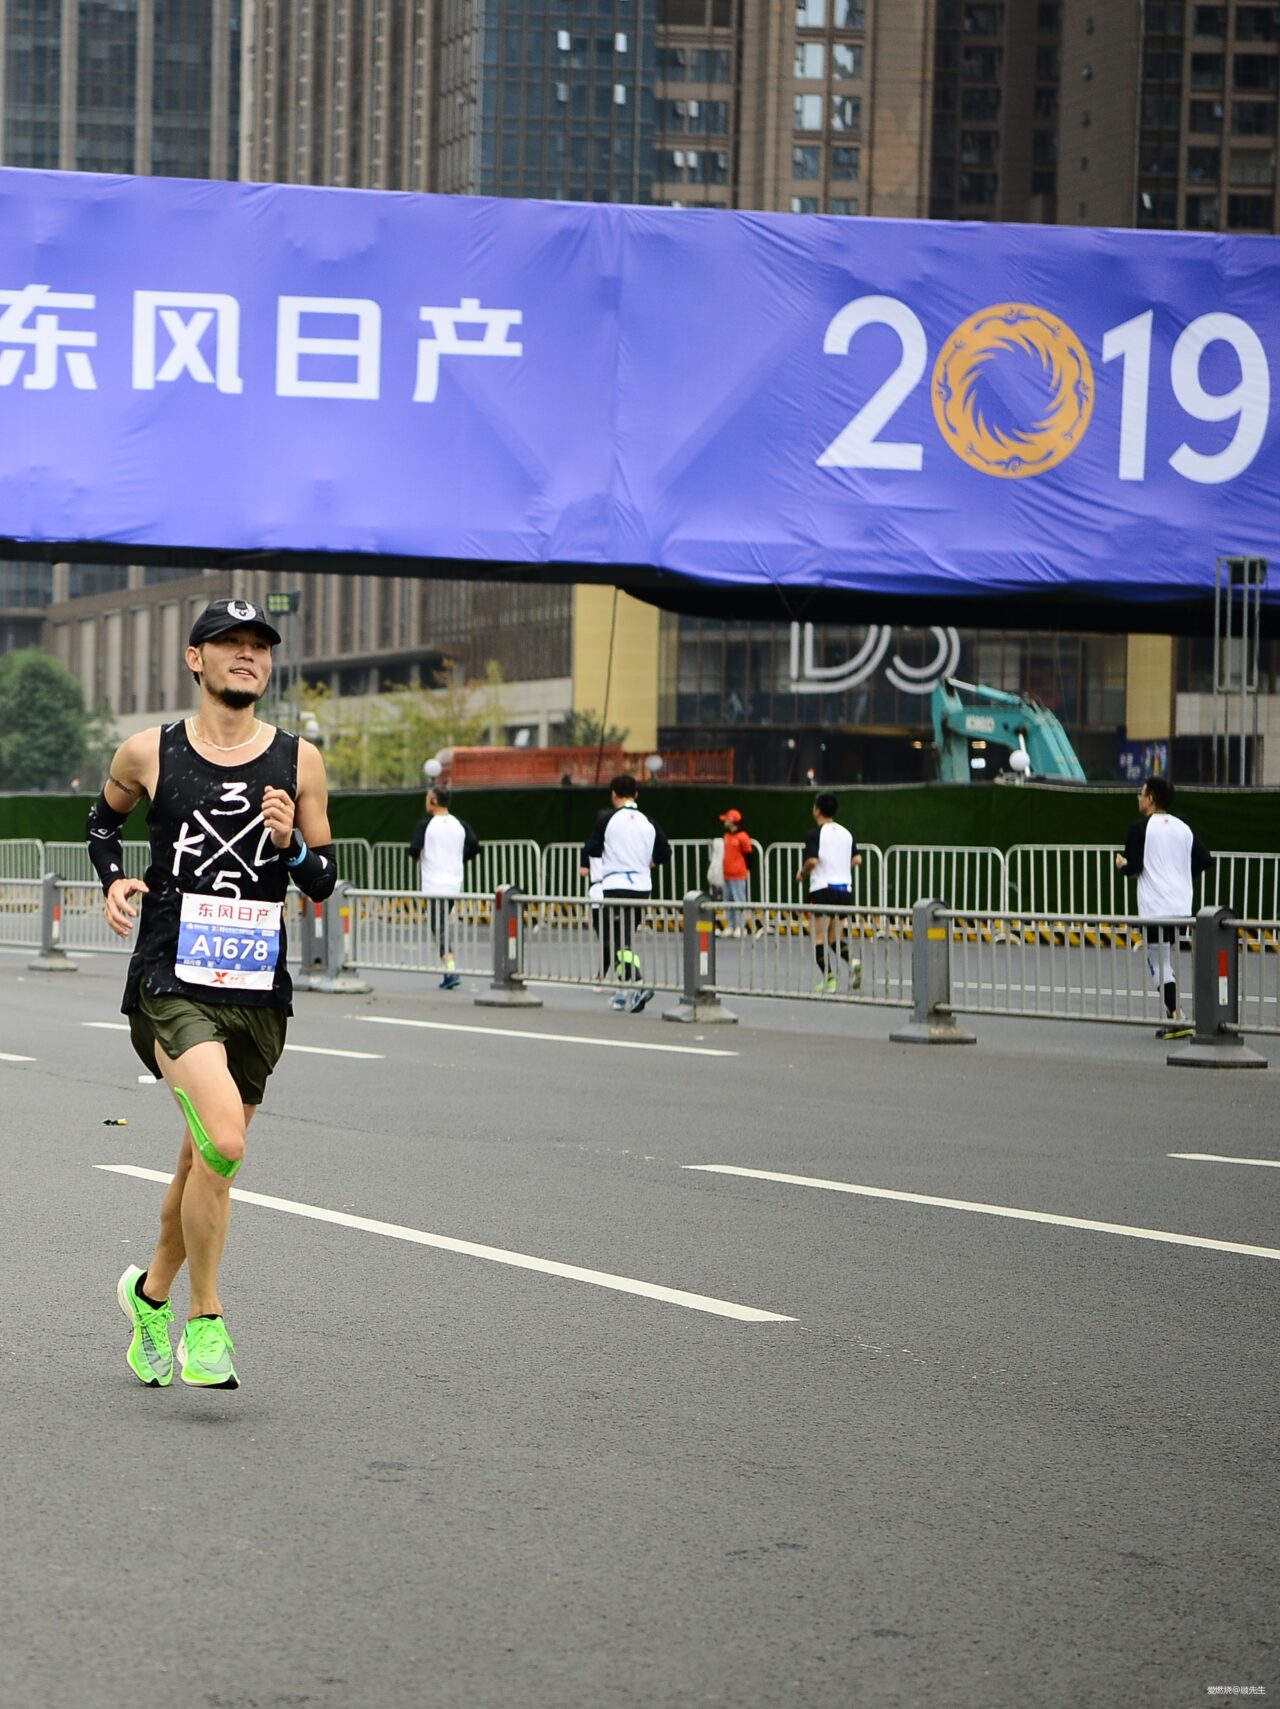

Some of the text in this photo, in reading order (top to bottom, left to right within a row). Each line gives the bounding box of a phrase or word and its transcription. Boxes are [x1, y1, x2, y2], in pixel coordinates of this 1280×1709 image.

[815, 294, 1271, 485] 2019
[198, 903, 270, 923] 东风日产
[189, 934, 269, 962] A1678
